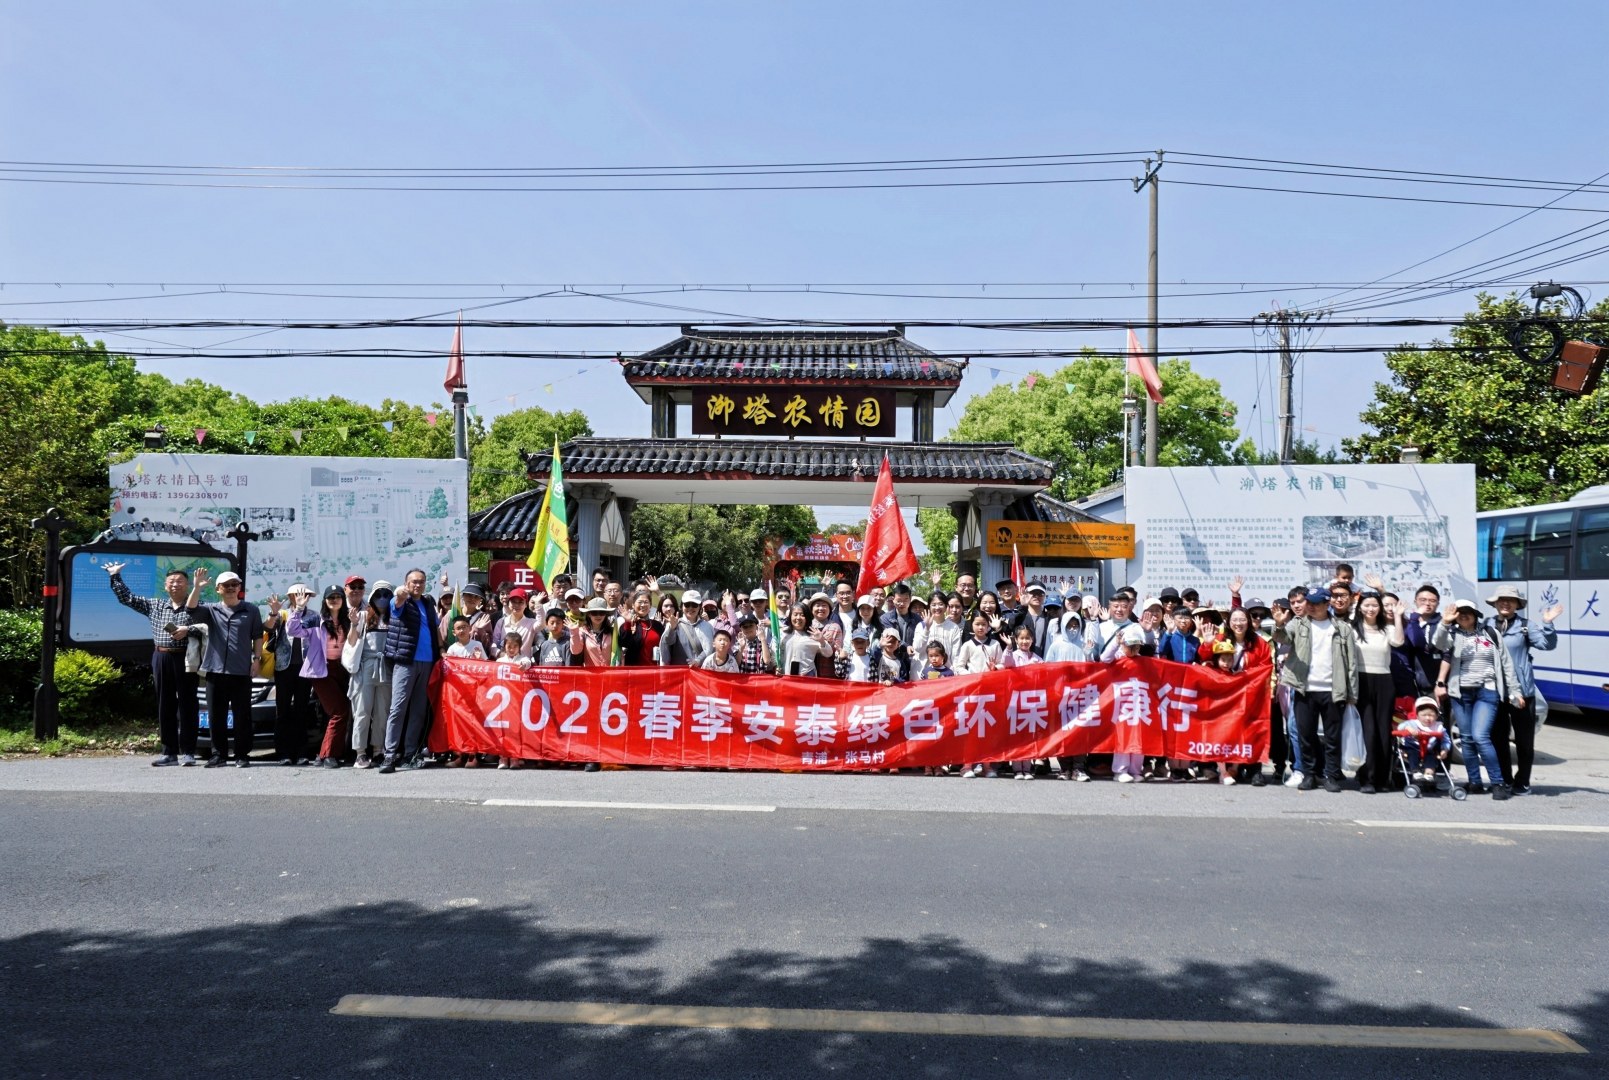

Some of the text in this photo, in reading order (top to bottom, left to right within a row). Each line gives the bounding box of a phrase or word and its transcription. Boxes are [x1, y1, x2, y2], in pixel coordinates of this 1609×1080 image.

[707, 393, 881, 429] 泖塔农情园
[1239, 475, 1347, 491] 泖塔农情园
[514, 568, 534, 586] 正
[483, 677, 1198, 746] 2026春季安泰绿色环保健康行
[1188, 741, 1253, 758] 2026年4月
